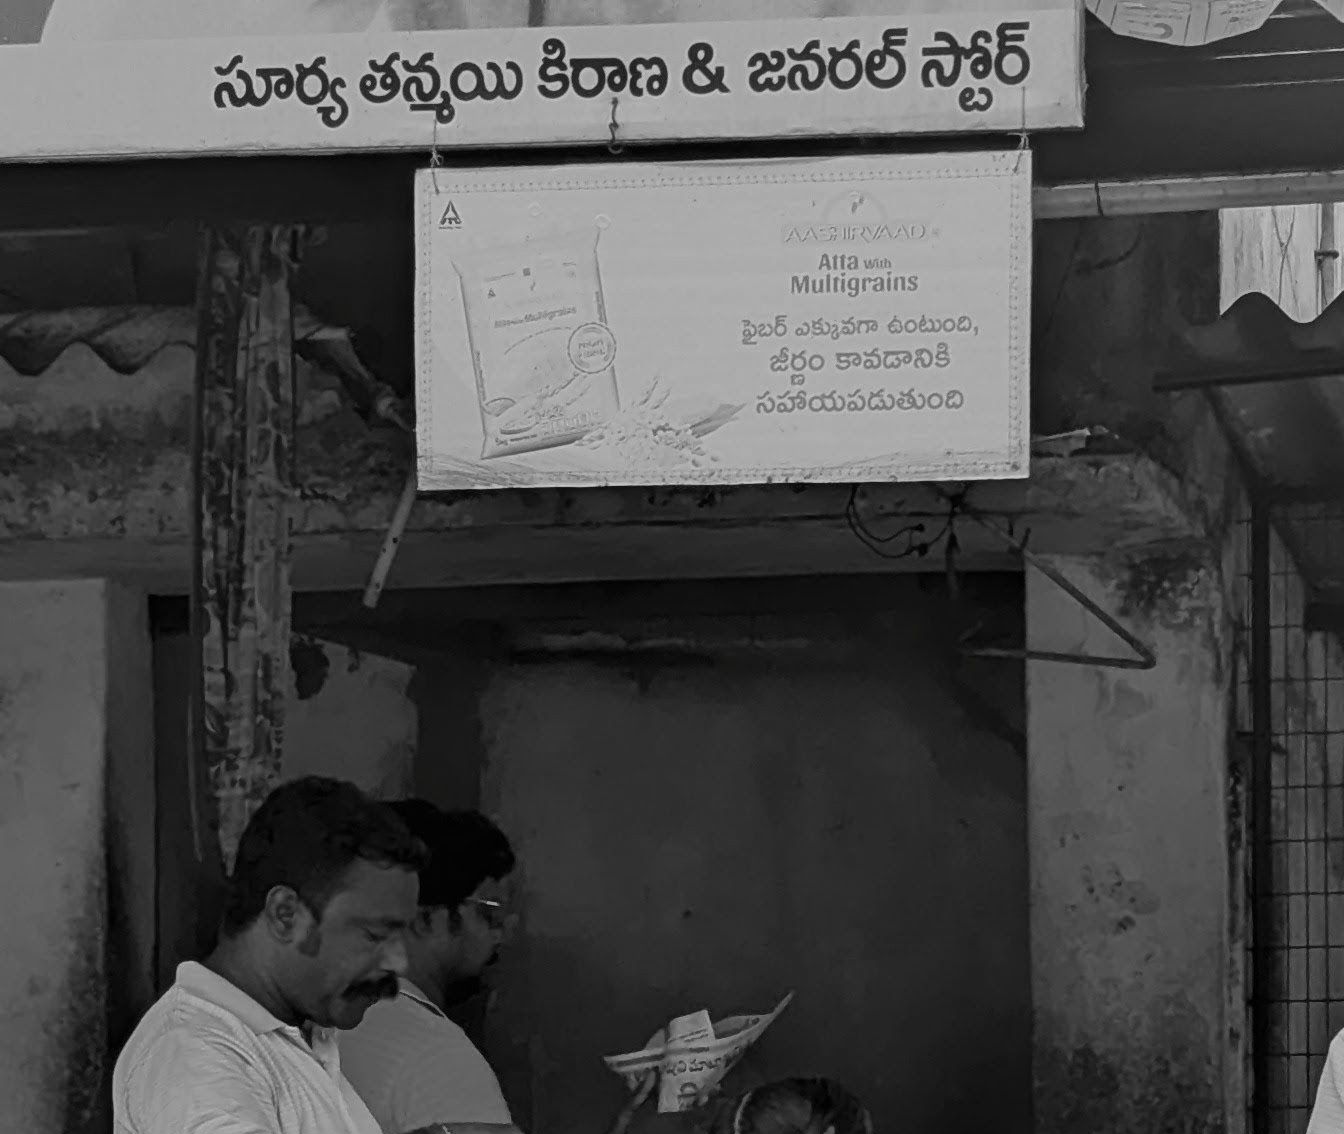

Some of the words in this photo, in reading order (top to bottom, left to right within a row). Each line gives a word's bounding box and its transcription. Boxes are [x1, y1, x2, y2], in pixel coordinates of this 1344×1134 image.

[213, 54, 349, 128] సూర్య
[359, 51, 523, 124] తన్మయి
[537, 37, 669, 98] కిరాణ
[682, 42, 730, 95] &
[747, 27, 908, 93] జనరల్
[921, 21, 1031, 112] స్టోర్
[818, 252, 860, 271] Atta
[790, 272, 919, 297] Multigrains
[835, 342, 952, 371] కావడానికి
[756, 389, 965, 414] సహాయపడుతుంది
